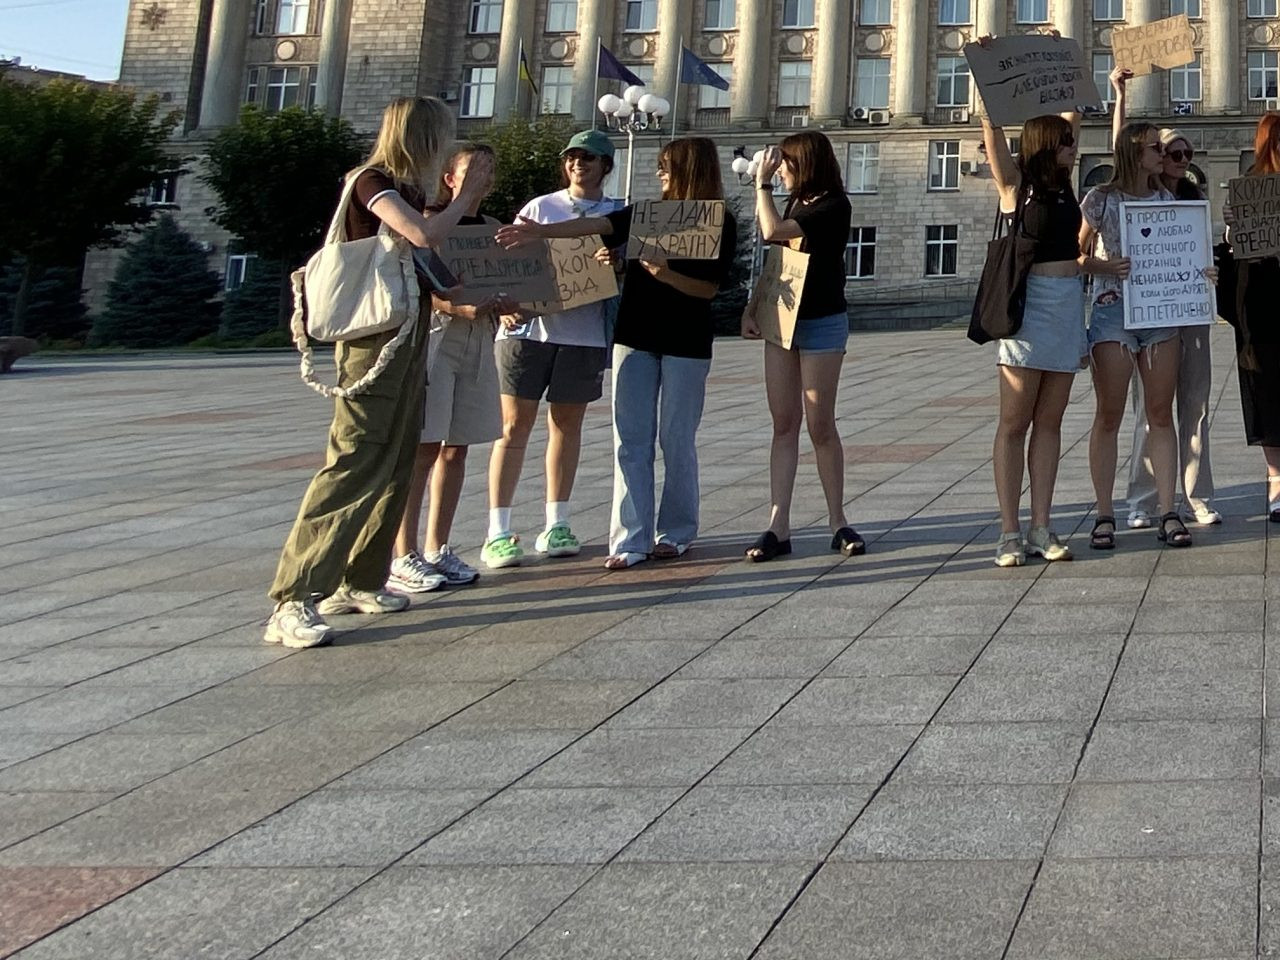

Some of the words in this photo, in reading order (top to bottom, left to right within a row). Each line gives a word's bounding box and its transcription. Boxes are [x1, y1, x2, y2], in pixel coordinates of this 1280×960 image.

[633, 200, 662, 224] НЕ
[667, 201, 724, 227] ДАМО
[1126, 213, 1133, 225] Я
[1138, 209, 1176, 223] ПРОСТО
[1157, 224, 1193, 237] ЛЮБЛЮ
[1129, 241, 1197, 256] ПЕРЕСІЧНОГО
